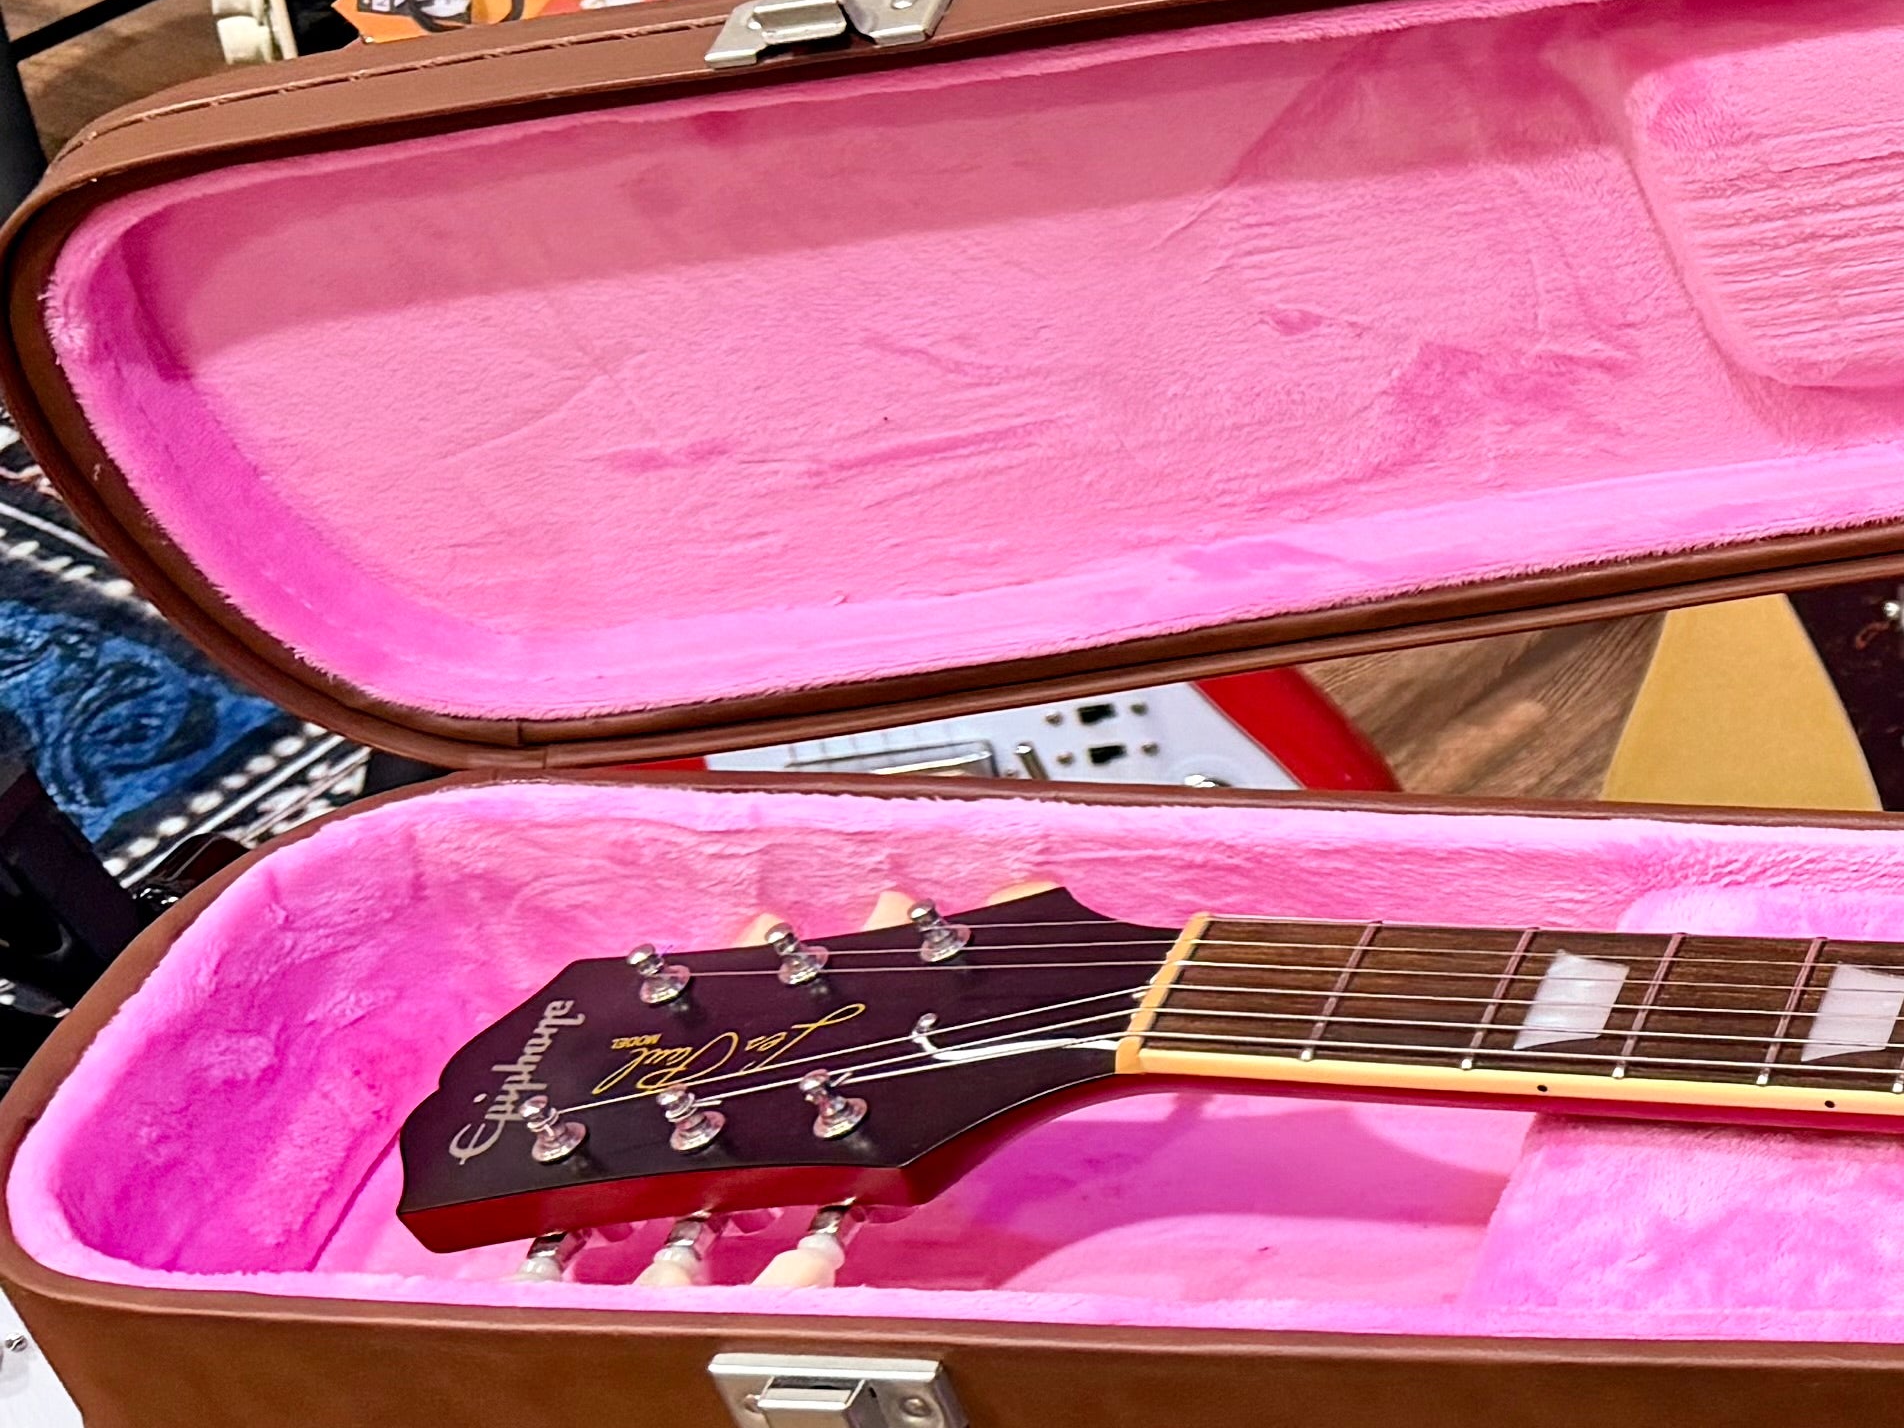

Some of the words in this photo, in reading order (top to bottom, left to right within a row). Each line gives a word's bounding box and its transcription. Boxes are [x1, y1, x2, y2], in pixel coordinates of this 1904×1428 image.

[592, 1032, 738, 1094] Paul
[611, 1032, 662, 1048] MODEL
[748, 1003, 866, 1075] Les
[447, 1000, 586, 1165] Epiphone
